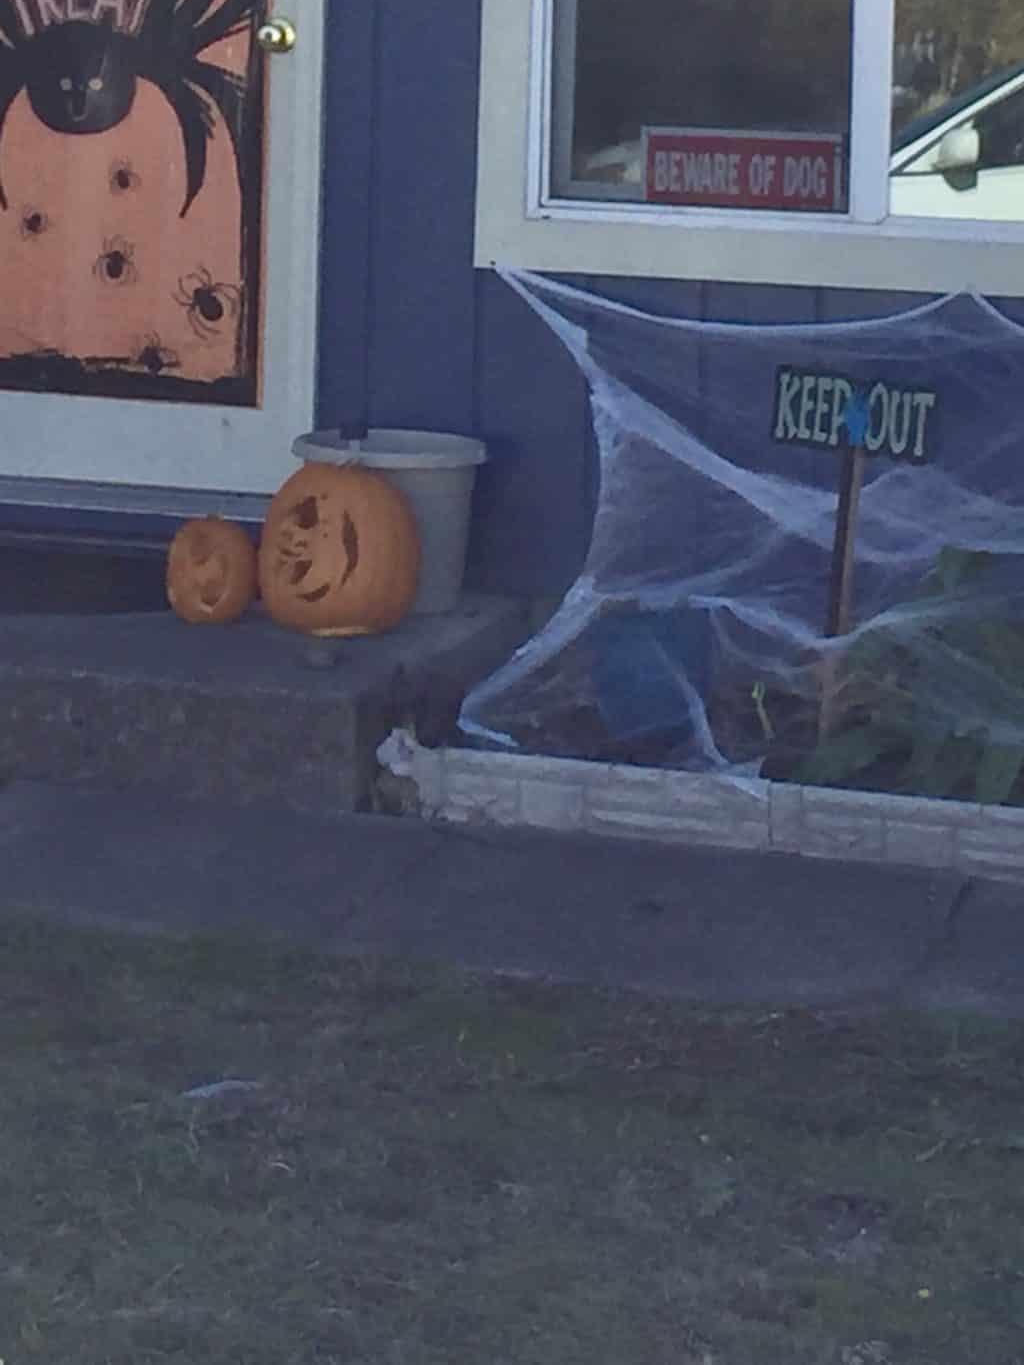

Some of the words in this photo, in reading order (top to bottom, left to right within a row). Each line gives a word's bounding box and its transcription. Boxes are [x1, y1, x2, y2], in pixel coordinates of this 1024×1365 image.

[654, 150, 742, 195] BEWARE
[749, 153, 777, 196] OF
[783, 155, 828, 198] DOG
[775, 372, 853, 446] KEEP
[865, 382, 937, 457] OUT
